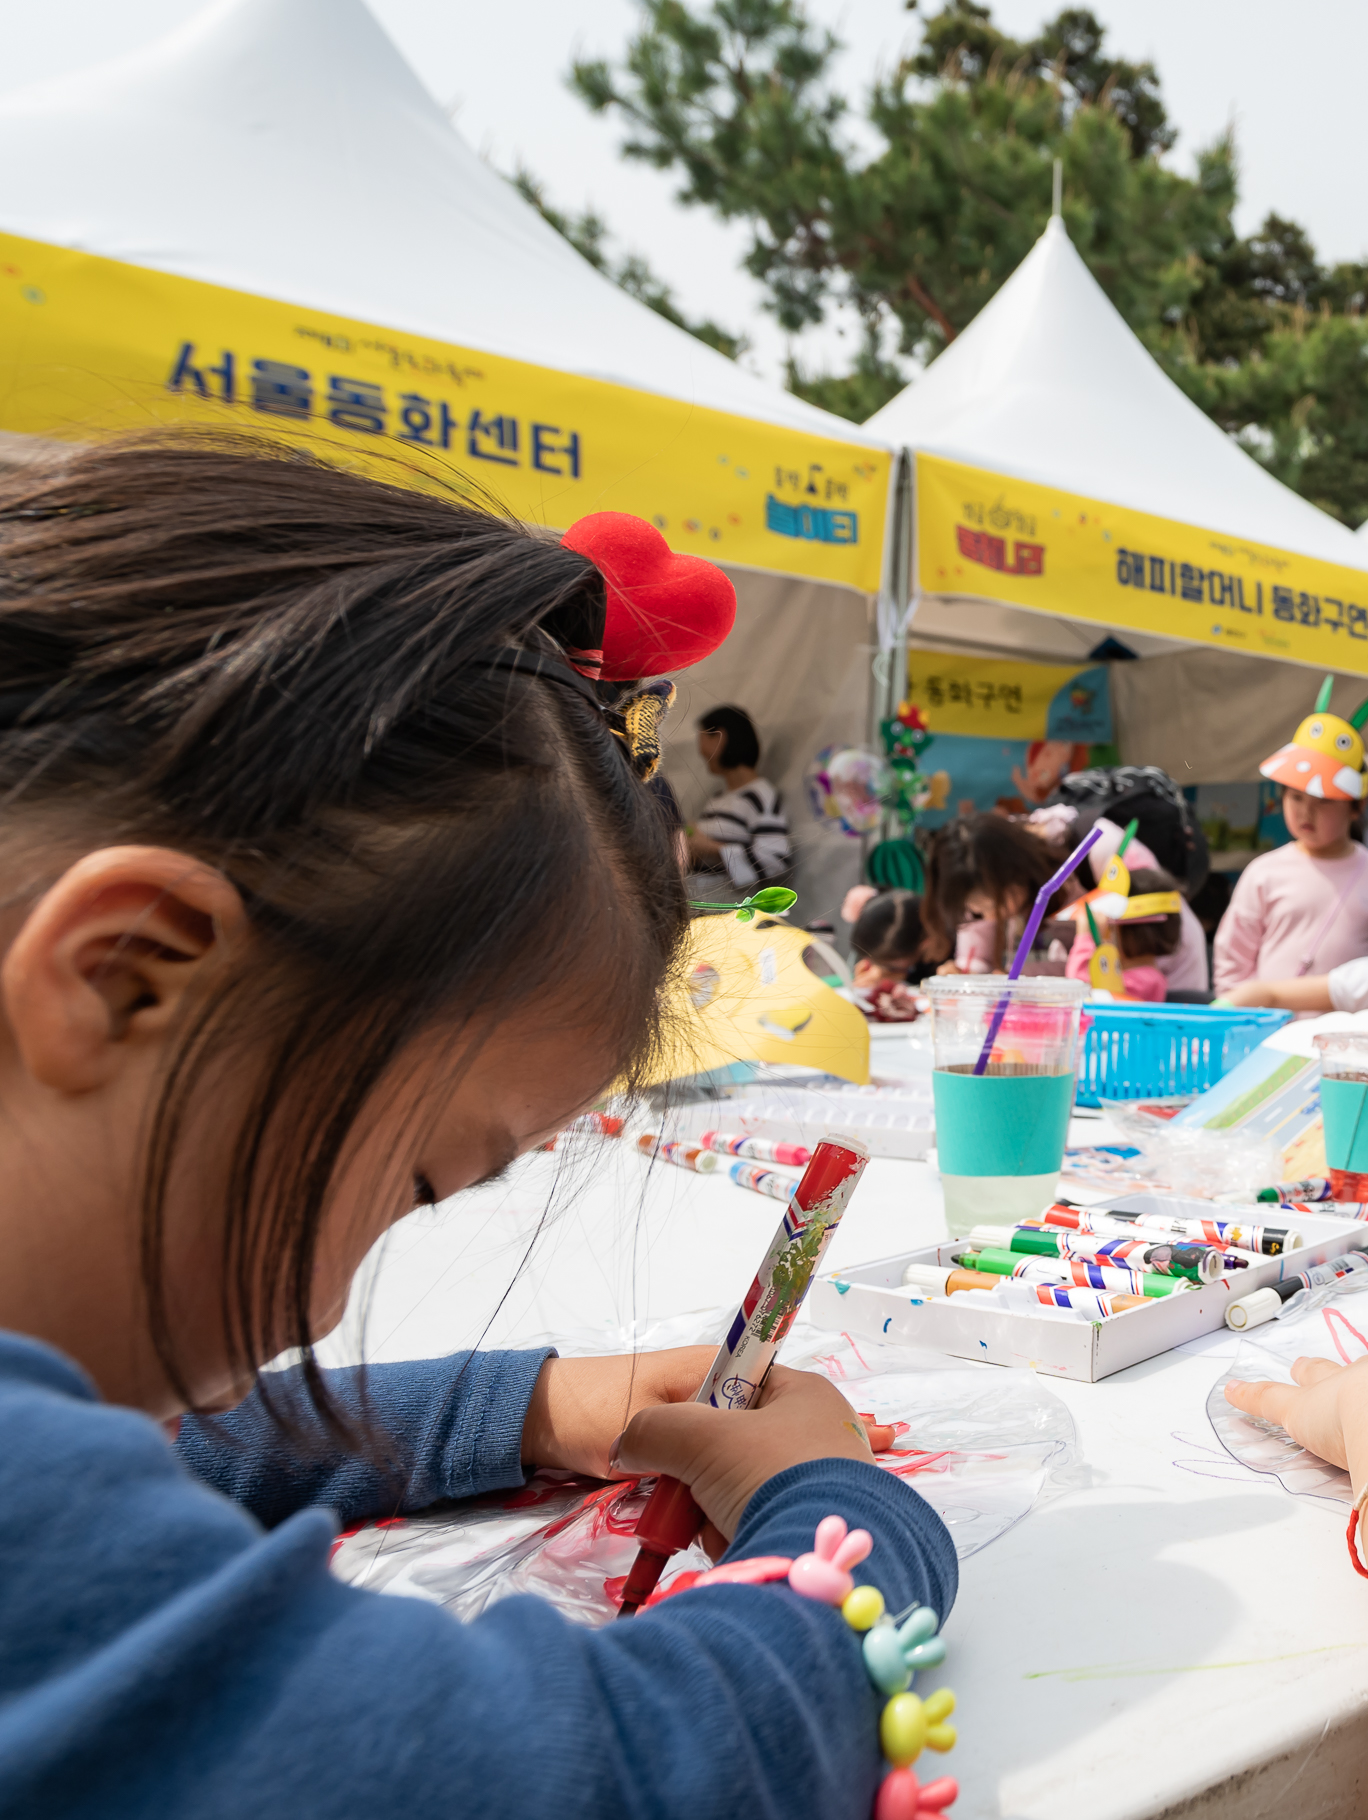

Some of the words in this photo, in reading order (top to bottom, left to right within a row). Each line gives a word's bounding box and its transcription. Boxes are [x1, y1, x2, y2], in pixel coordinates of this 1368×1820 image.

[168, 341, 582, 480] 서울동화센터
[1117, 548, 1264, 616] 해피할머니
[735, 1336, 750, 1358] KOREA
